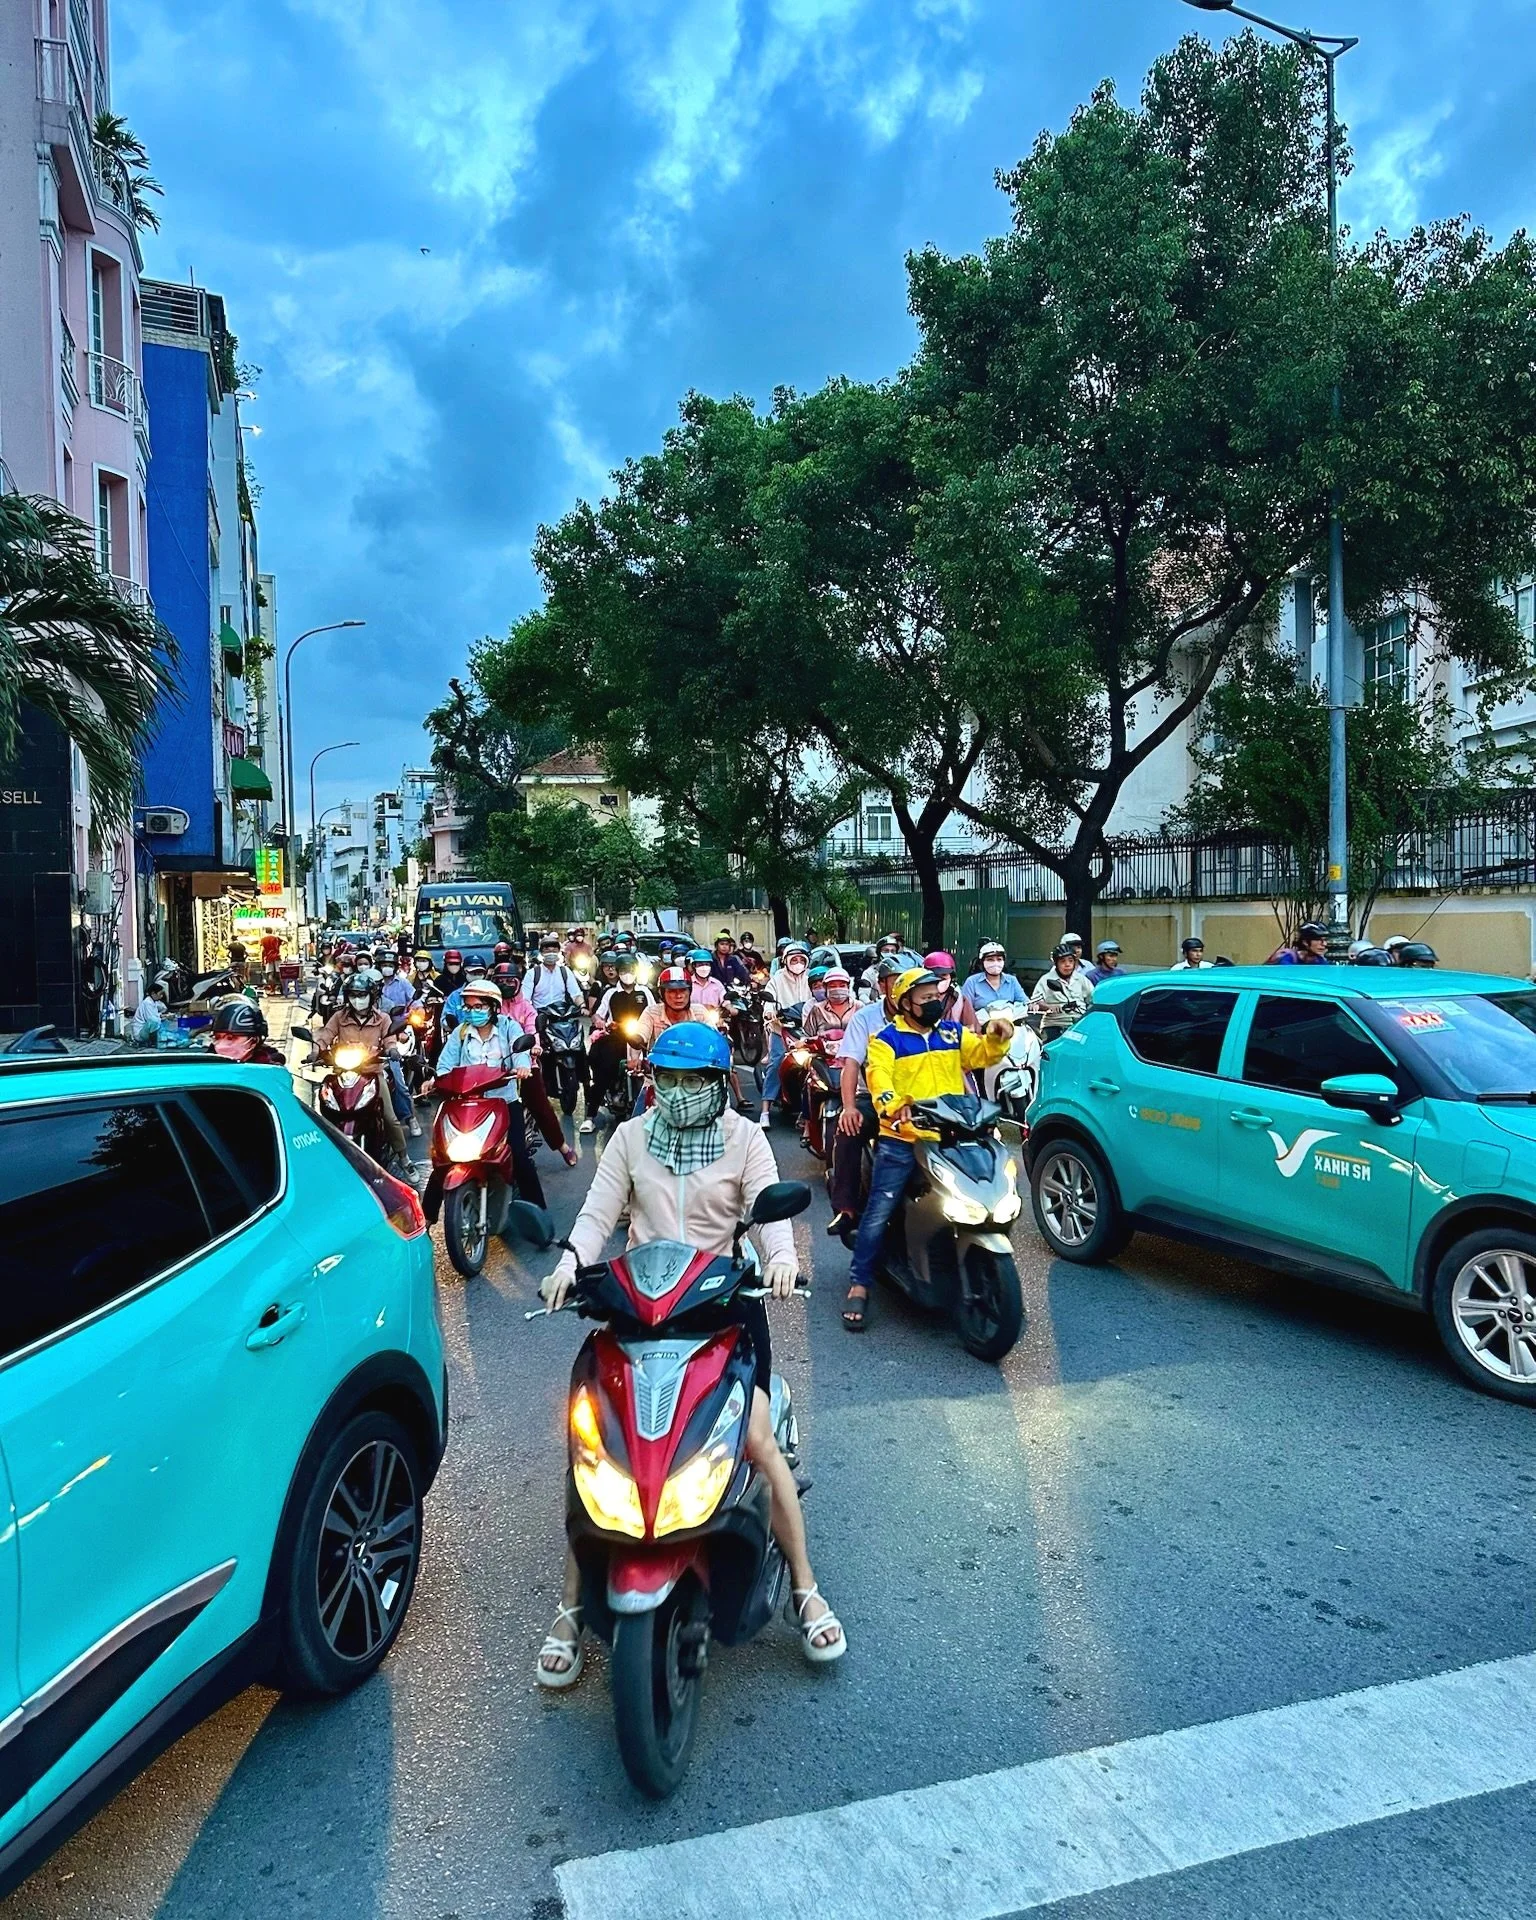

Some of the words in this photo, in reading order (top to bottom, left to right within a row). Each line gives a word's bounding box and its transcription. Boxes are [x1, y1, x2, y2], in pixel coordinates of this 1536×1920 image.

[0, 791, 42, 804] SELL
[430, 895, 462, 908] HAI
[464, 895, 503, 906] VAN
[1314, 1155, 1350, 1177] XANH
[1352, 1163, 1371, 1181] SM
